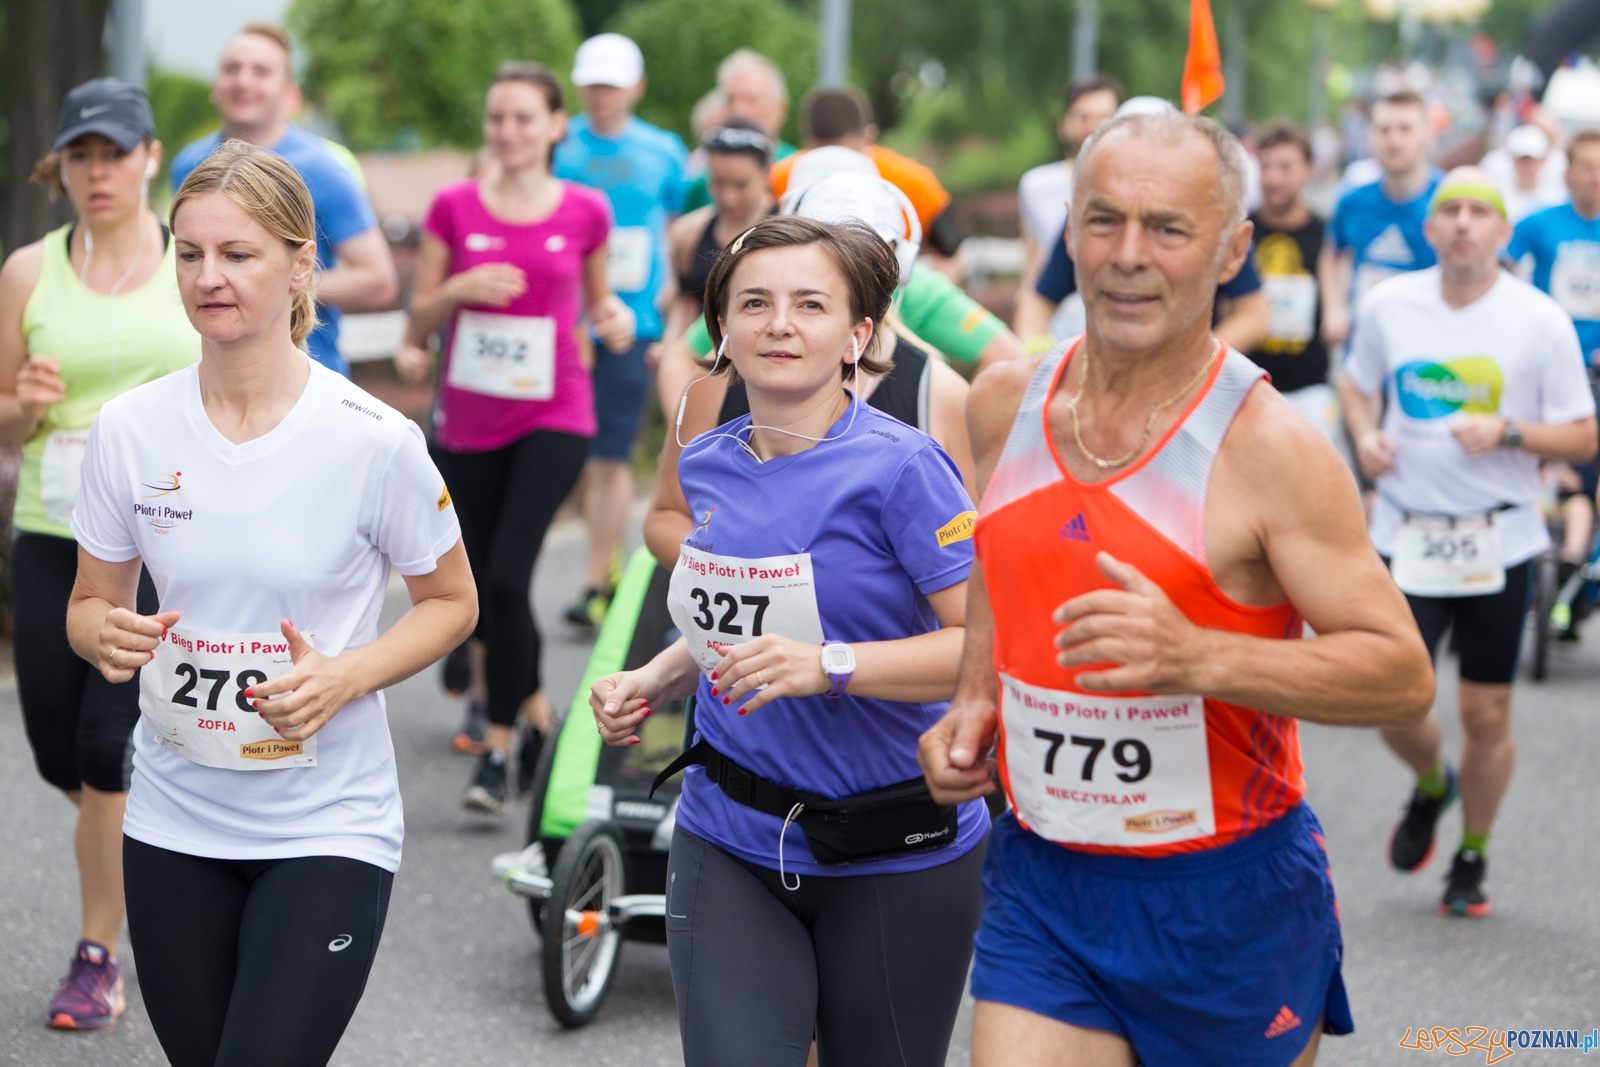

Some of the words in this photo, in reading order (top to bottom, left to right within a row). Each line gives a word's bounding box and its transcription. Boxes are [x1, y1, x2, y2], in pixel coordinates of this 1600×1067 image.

[341, 398, 383, 421] newline
[134, 504, 156, 517] Piotr
[158, 506, 161, 517] i
[164, 506, 193, 520] Paweł
[939, 525, 961, 542] Piotr
[962, 521, 967, 530] i
[688, 556, 706, 576] Bieg
[709, 562, 736, 578] Piotr
[740, 566, 745, 579] i
[748, 563, 800, 579] Paweł
[690, 587, 770, 637] 327
[171, 632, 193, 653] Bieg
[196, 640, 234, 654] Piotr
[240, 642, 245, 654] i
[251, 641, 291, 654] Paw
[171, 662, 269, 713] 278
[1024, 695, 1059, 716] Bieg
[1064, 702, 1108, 720] Piotr
[1114, 706, 1120, 721] i
[1127, 702, 1189, 721] Paweł
[198, 718, 237, 732] ZOFIA
[242, 745, 265, 755] Piotr
[267, 743, 271, 753] i
[273, 742, 300, 752] Paweł
[1033, 728, 1152, 784] 779
[1045, 785, 1147, 806] MIECZYSŁAW
